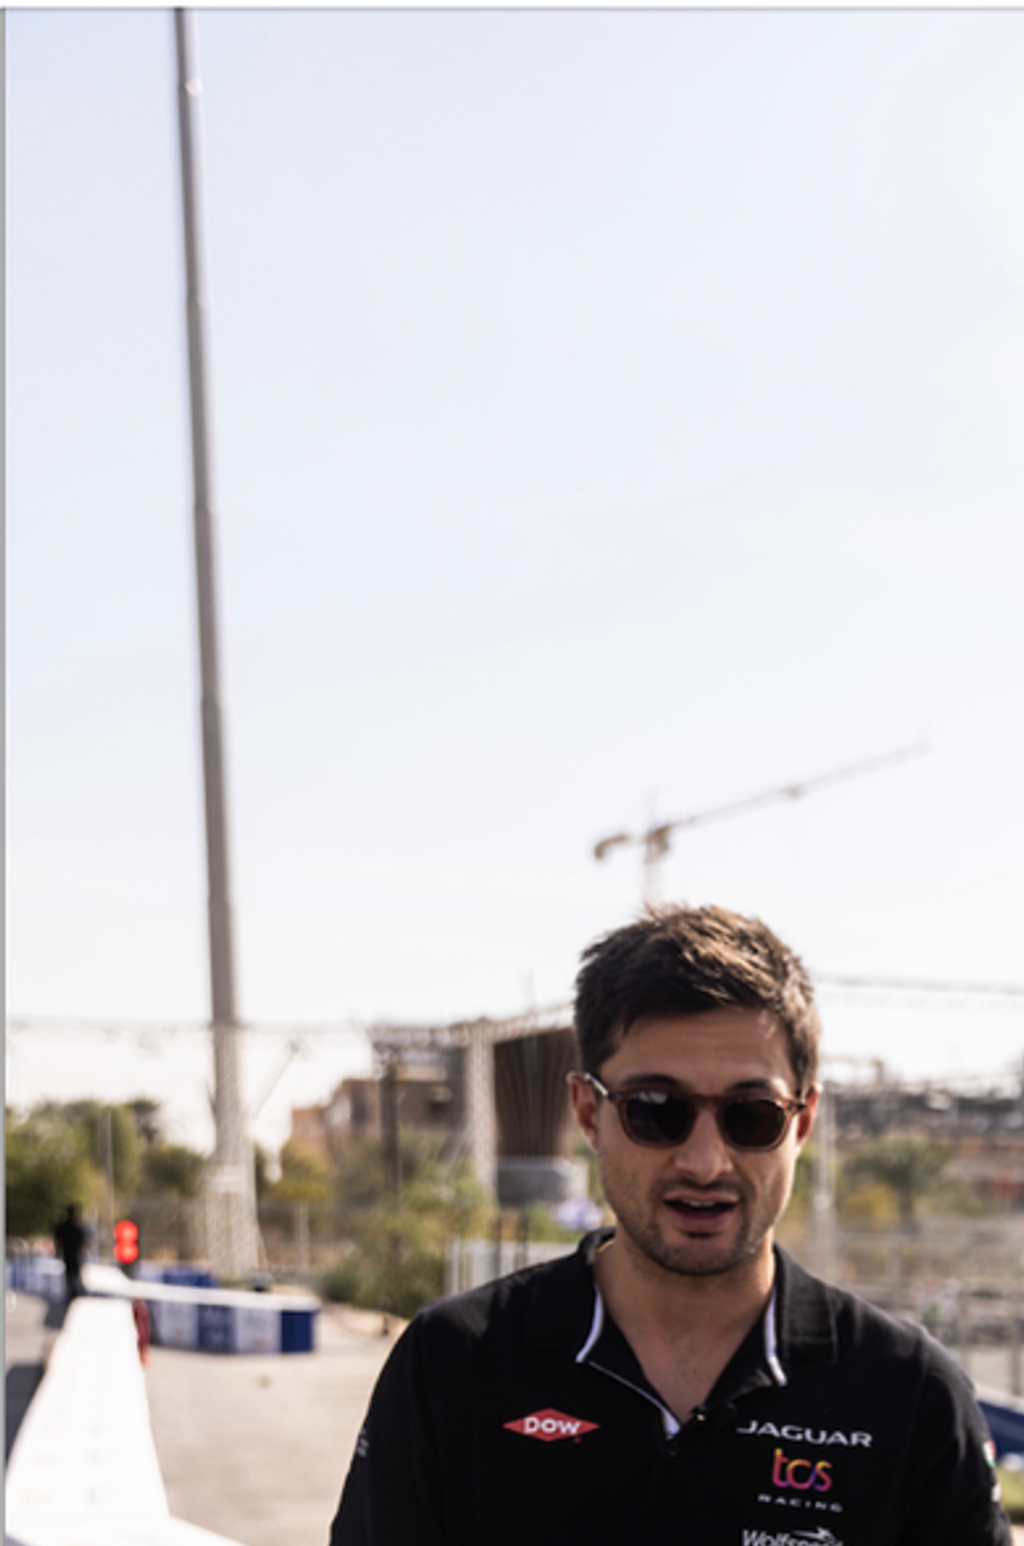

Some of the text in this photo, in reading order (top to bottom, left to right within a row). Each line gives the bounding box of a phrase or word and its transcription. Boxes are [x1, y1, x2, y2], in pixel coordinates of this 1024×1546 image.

[524, 1417, 582, 1434] DOW
[737, 1420, 873, 1448] JAGUAR
[772, 1448, 832, 1492] tcs
[757, 1494, 843, 1513] RACING
